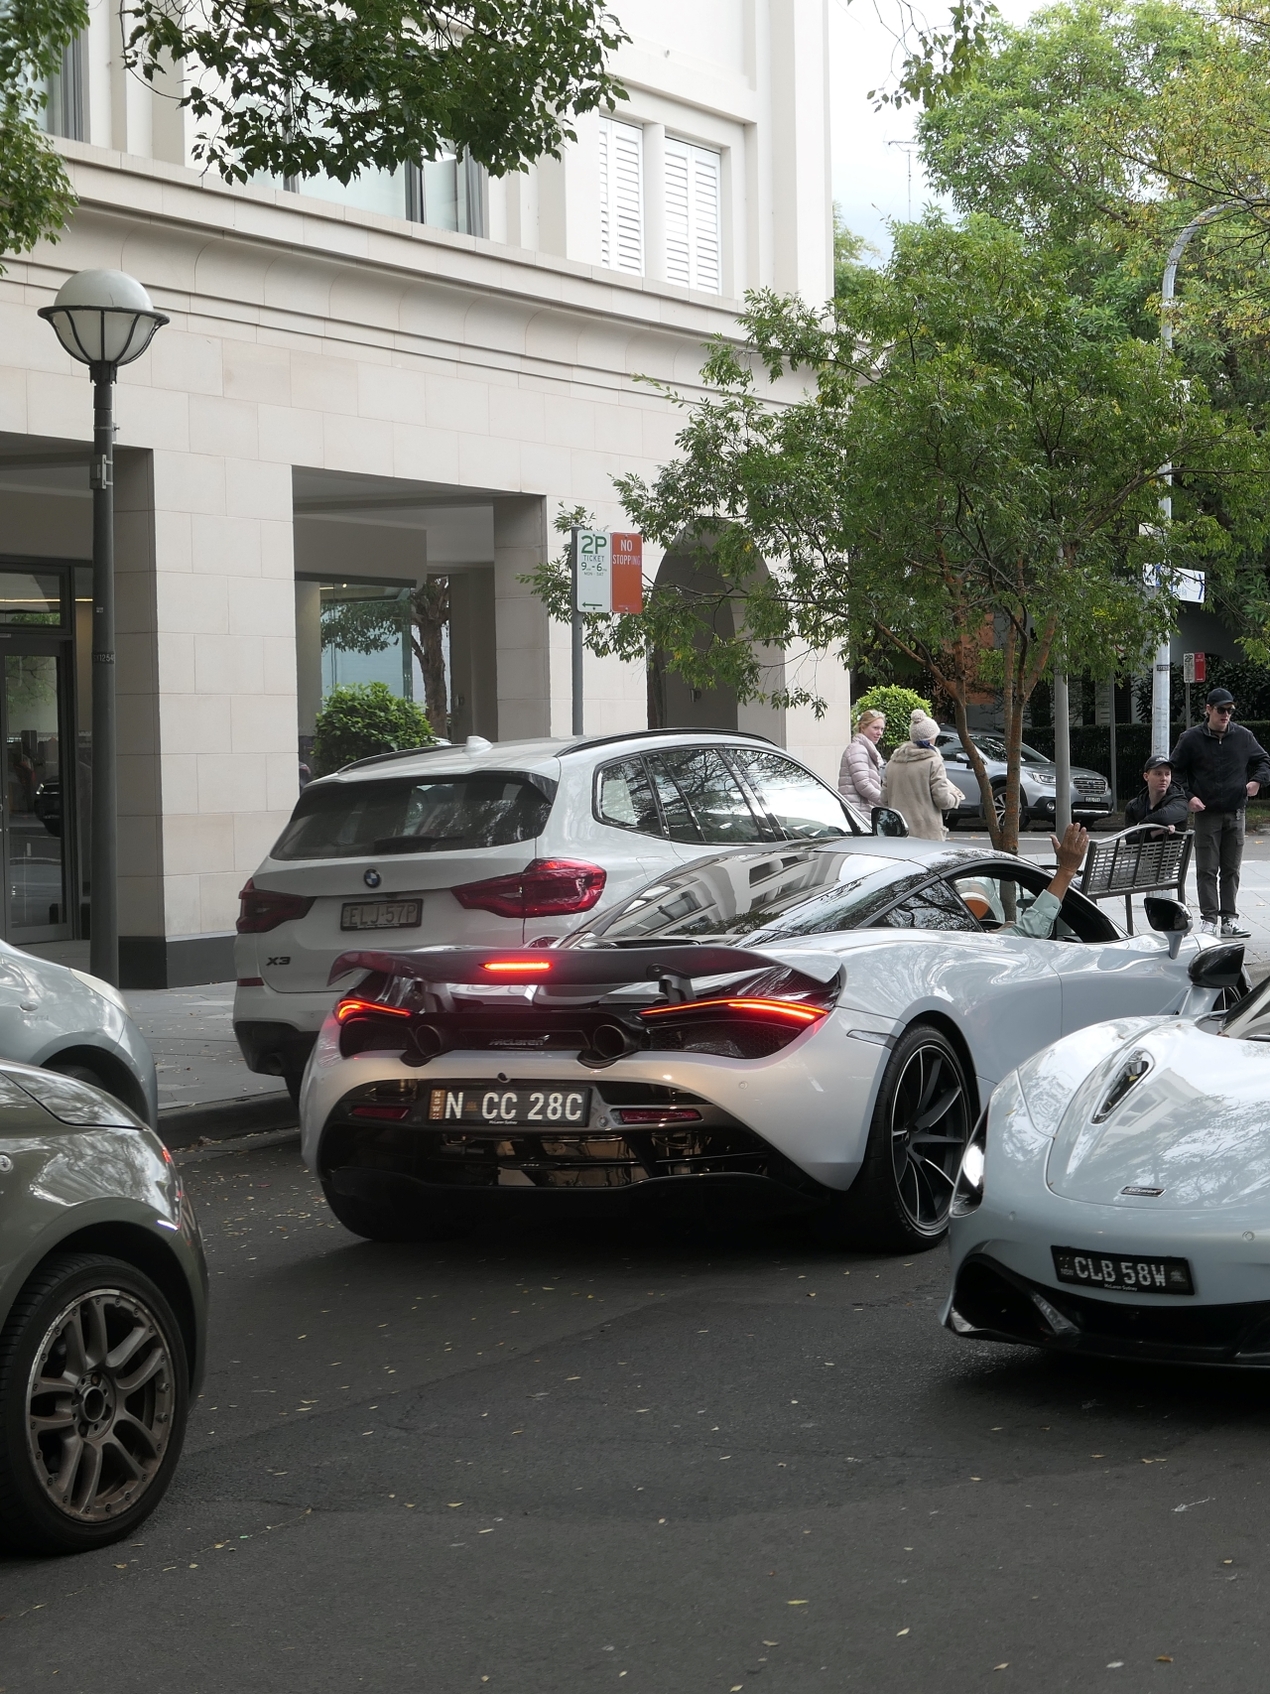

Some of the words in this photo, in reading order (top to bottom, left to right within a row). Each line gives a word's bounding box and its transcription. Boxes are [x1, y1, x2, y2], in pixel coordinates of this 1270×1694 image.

[581, 535, 608, 554] 2P
[620, 540, 633, 552] NO
[612, 554, 641, 566] STOPPING
[266, 956, 291, 966] X3
[488, 1037, 544, 1046] McLaren
[445, 1091, 464, 1119] N
[481, 1092, 518, 1120] CC
[527, 1092, 583, 1121] 28C
[1074, 1256, 1116, 1282] CLB
[1120, 1262, 1166, 1287] 58W
[1122, 1284, 1138, 1292] Sydney
